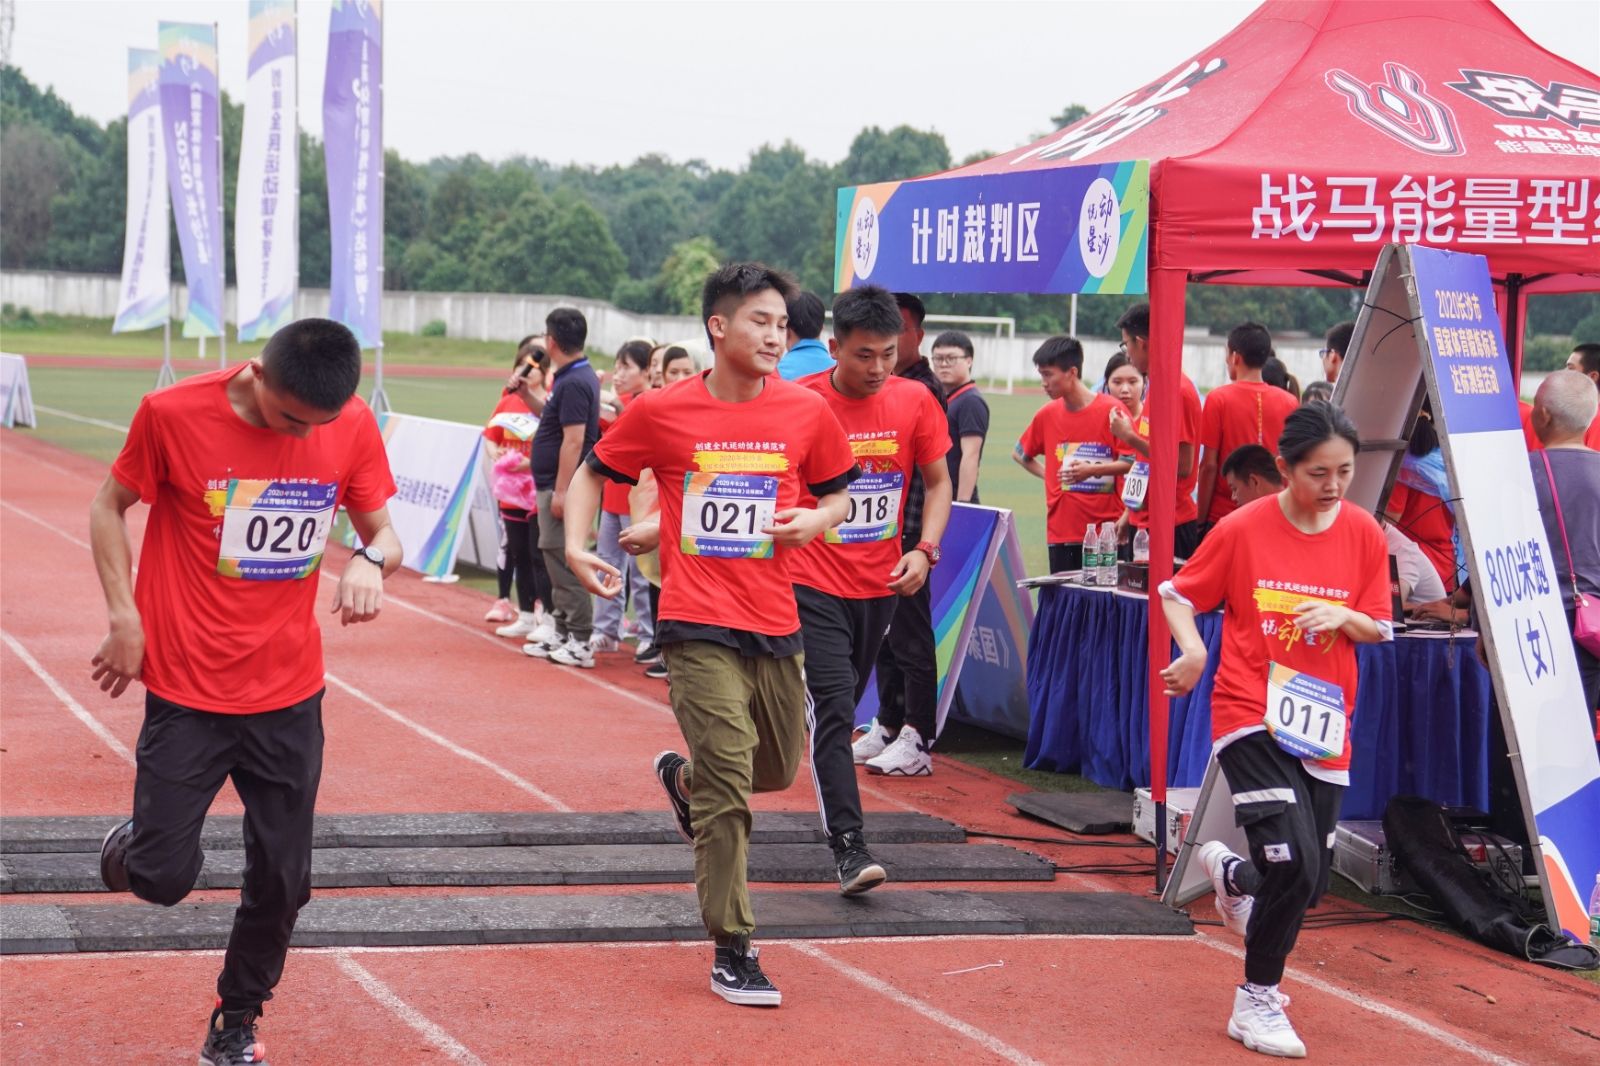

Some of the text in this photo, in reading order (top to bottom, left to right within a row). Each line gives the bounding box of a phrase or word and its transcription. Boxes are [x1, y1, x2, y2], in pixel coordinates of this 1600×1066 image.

[1251, 173, 1600, 246] 战马能量型
[911, 201, 1041, 265] 计时裁判区
[1435, 289, 1482, 322] 2020长沙市
[1433, 327, 1499, 359] 国家体育锻炼标准
[695, 442, 787, 452] 创建全民运动健身模范市
[245, 515, 317, 554] 020
[701, 501, 757, 535] 021
[1484, 537, 1550, 608] 800米跑
[1279, 696, 1331, 743] 011
